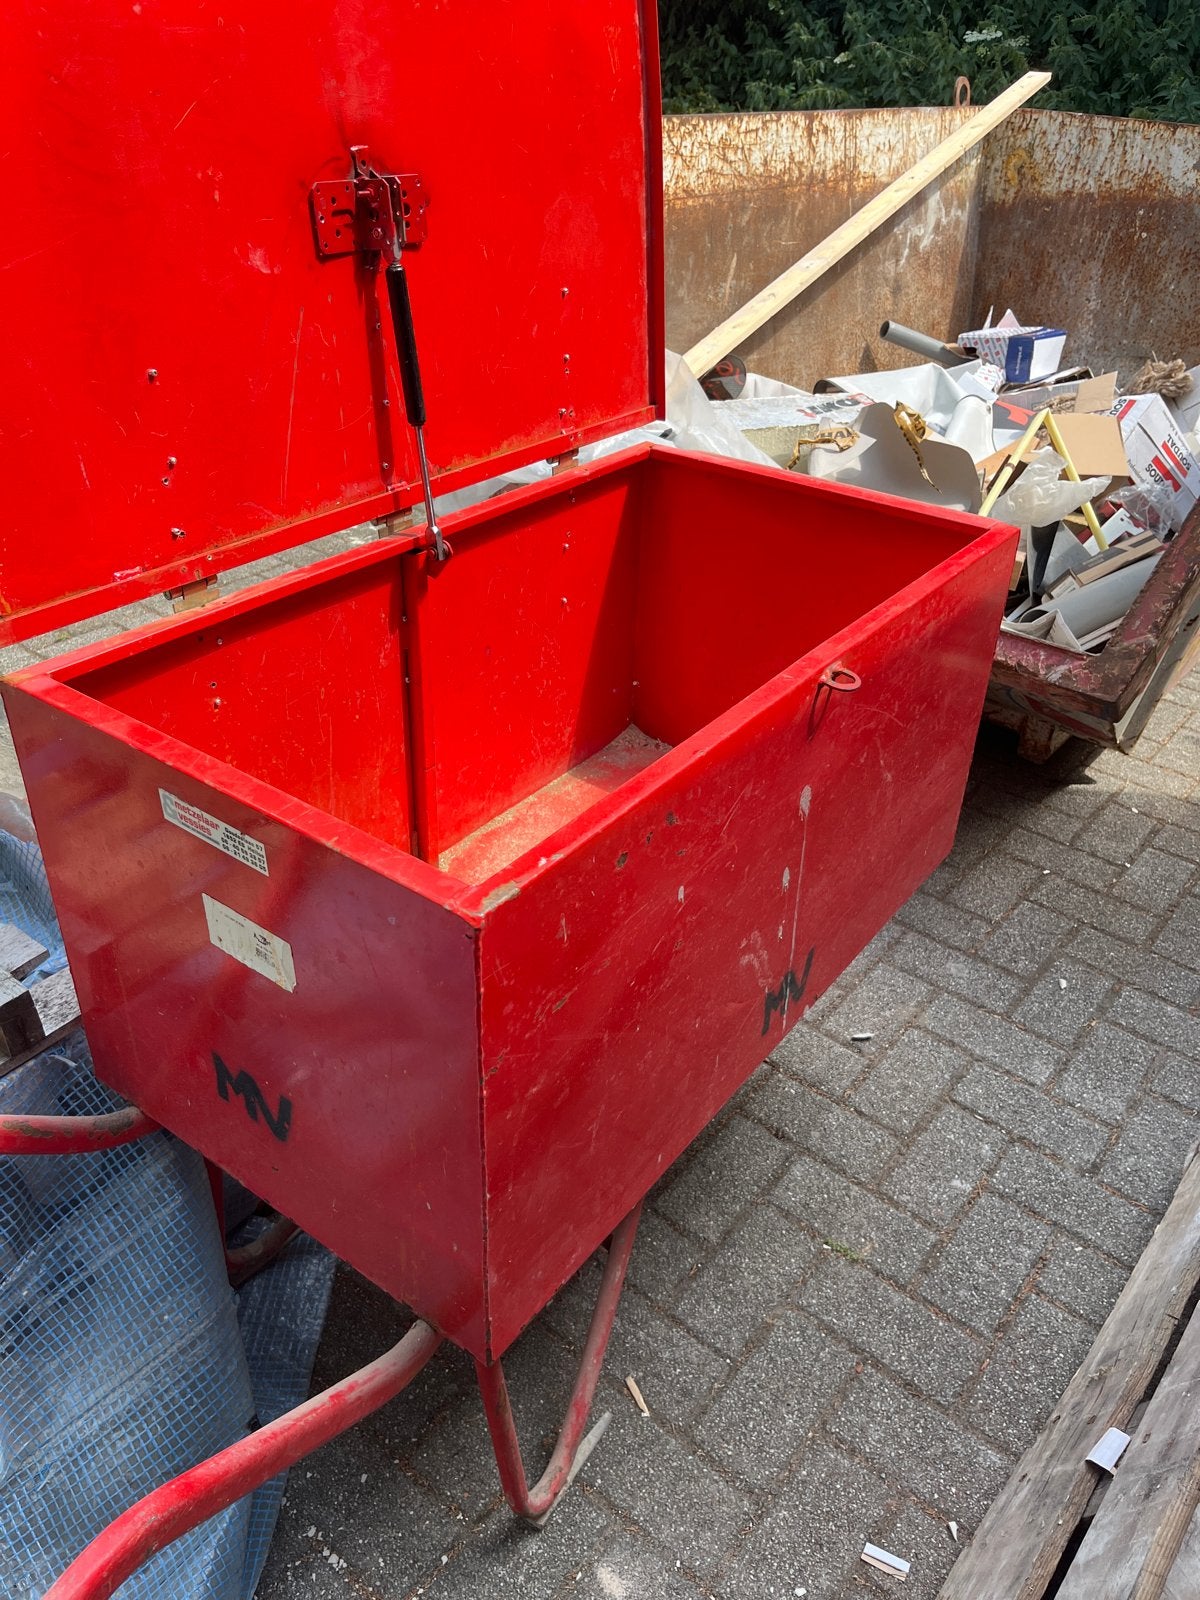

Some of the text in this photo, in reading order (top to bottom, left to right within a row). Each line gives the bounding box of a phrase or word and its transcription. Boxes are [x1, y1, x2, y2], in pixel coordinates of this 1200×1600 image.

[1109, 398, 1127, 416] SOU
[1167, 433, 1191, 471] SOUDAL
[174, 801, 220, 830] metzelaar
